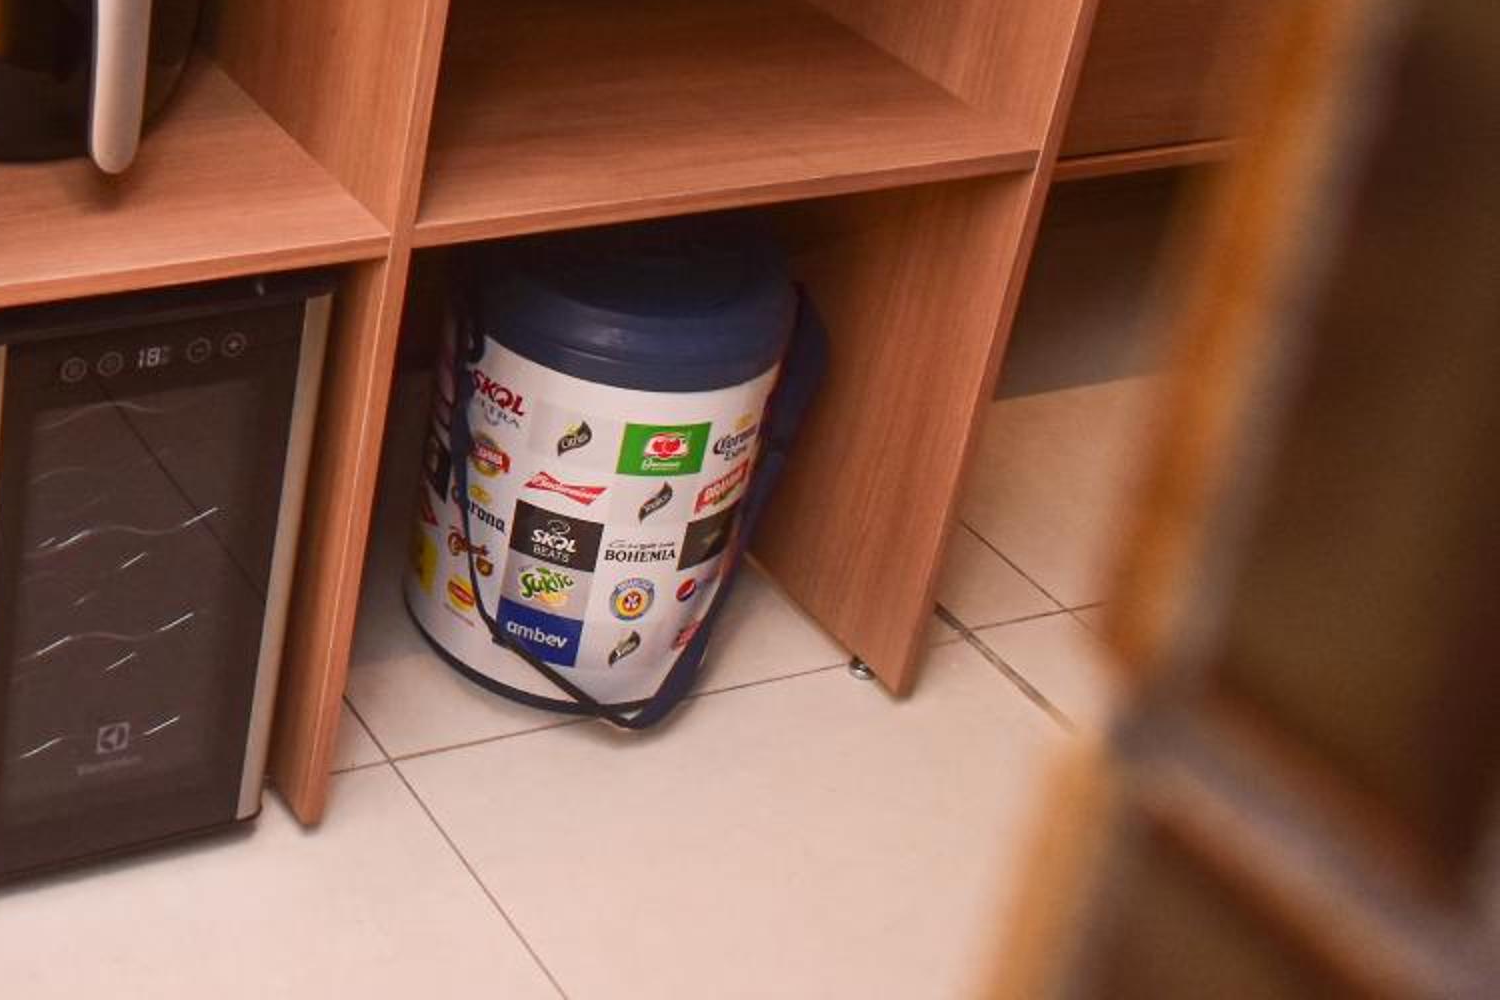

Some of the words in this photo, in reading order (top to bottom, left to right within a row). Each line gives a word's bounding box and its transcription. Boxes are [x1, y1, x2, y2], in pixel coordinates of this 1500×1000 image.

[470, 369, 524, 416] SKOL
[531, 529, 577, 553] SKOL
[533, 545, 571, 563] BEATS
[604, 549, 676, 563] BOHEMIA
[507, 620, 569, 649] ambev
